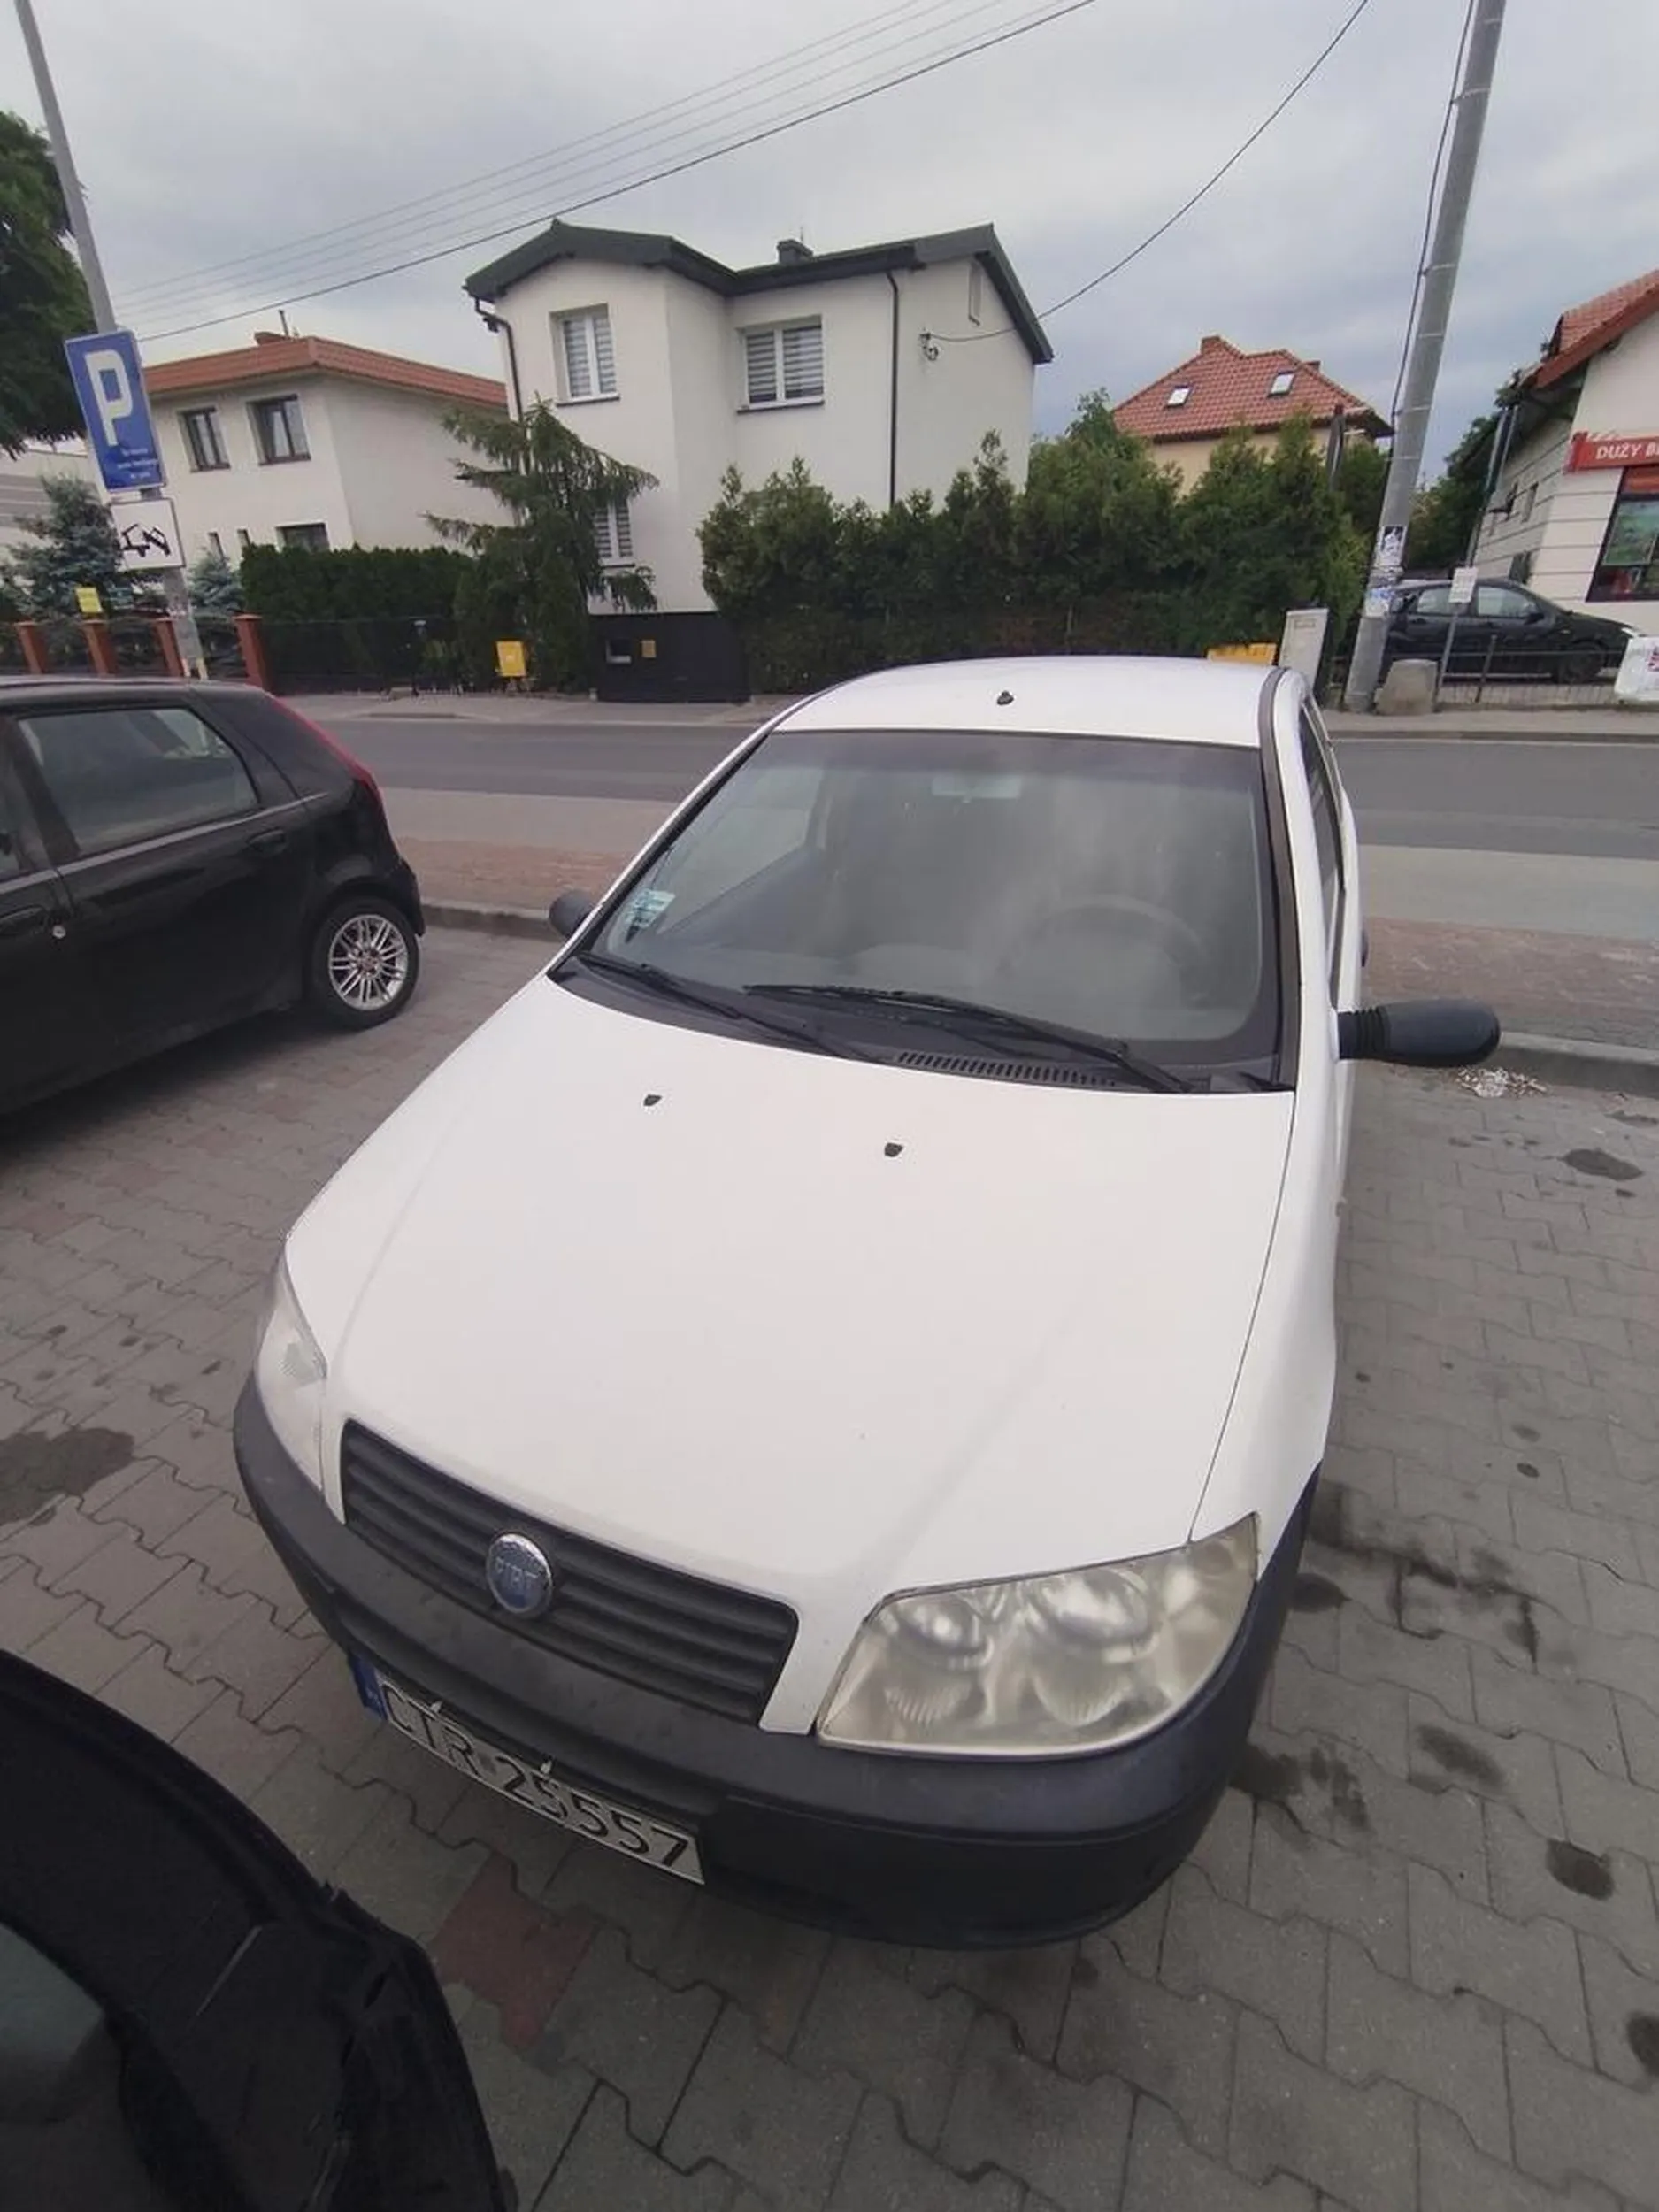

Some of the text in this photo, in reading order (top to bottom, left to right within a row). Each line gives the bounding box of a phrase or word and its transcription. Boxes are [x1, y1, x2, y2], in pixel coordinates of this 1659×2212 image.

[84, 349, 133, 447] P
[381, 1683, 689, 1868] CTR 25557
